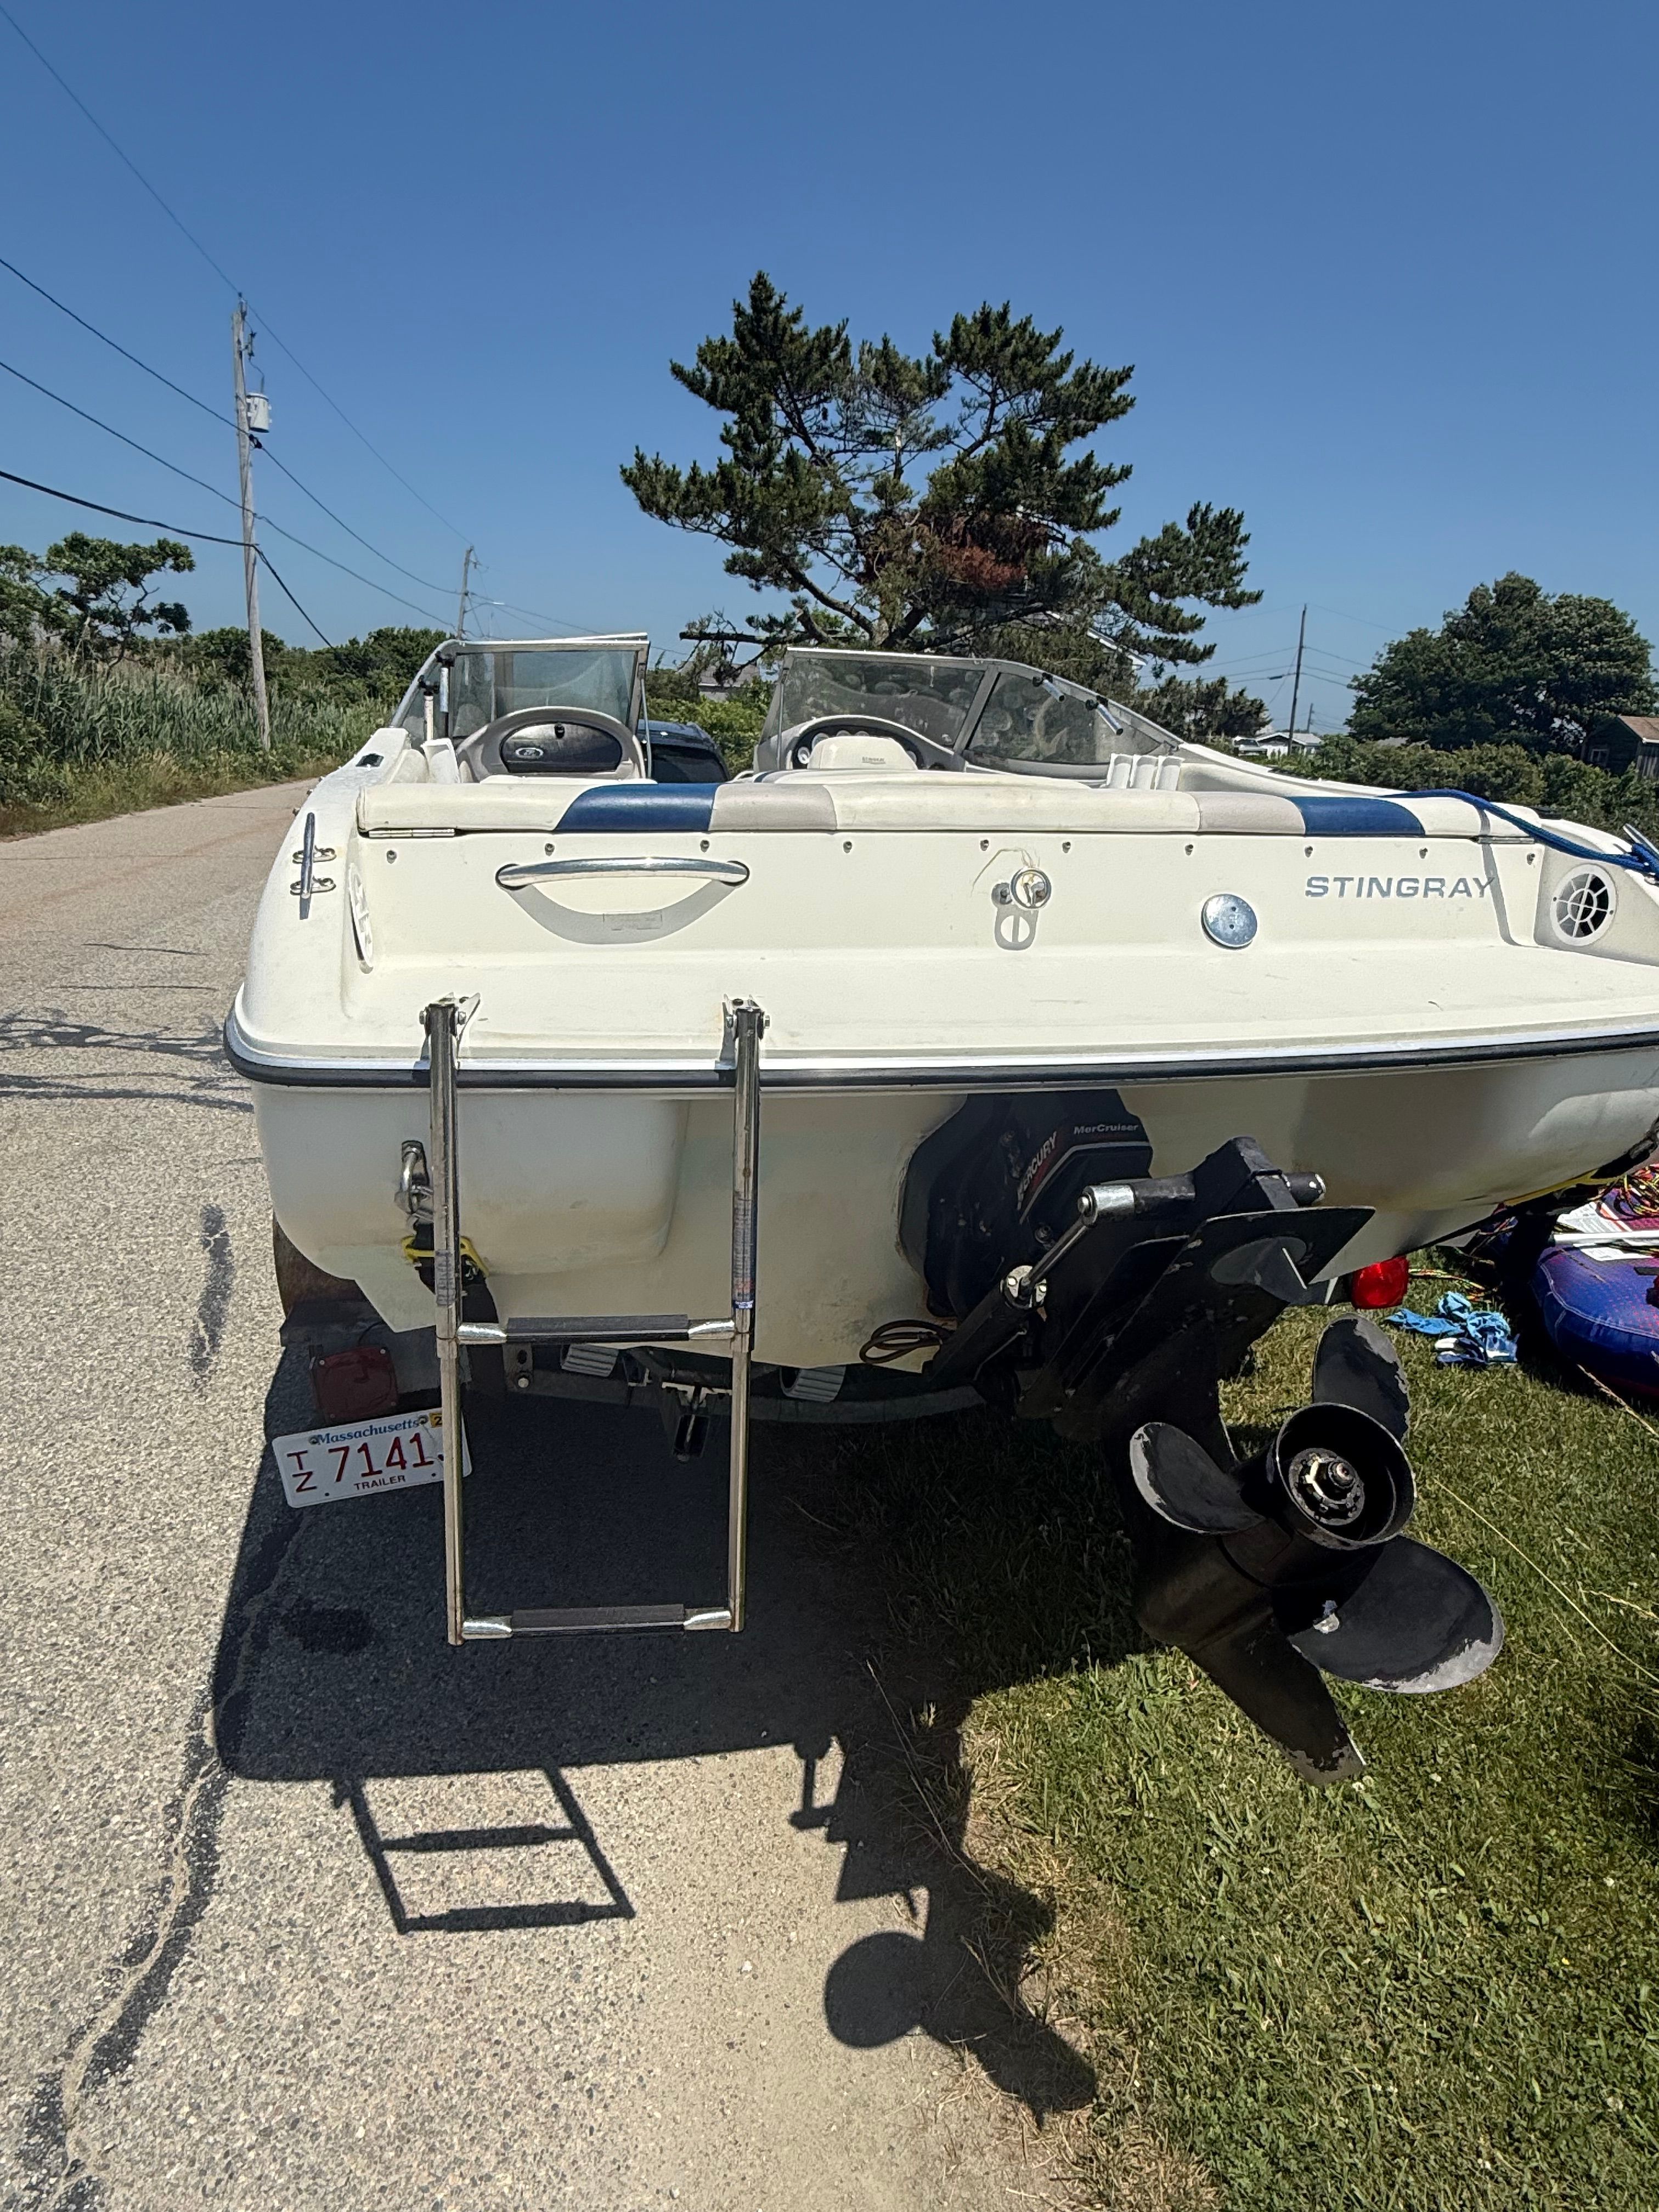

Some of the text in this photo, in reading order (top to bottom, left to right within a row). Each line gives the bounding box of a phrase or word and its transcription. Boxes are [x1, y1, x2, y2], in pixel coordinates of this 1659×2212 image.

[1305, 876, 1494, 898] STINGRAY
[317, 1418, 420, 1446] Massachusetts
[328, 1432, 435, 1483] 7141
[353, 1474, 407, 1491] TRAILER
